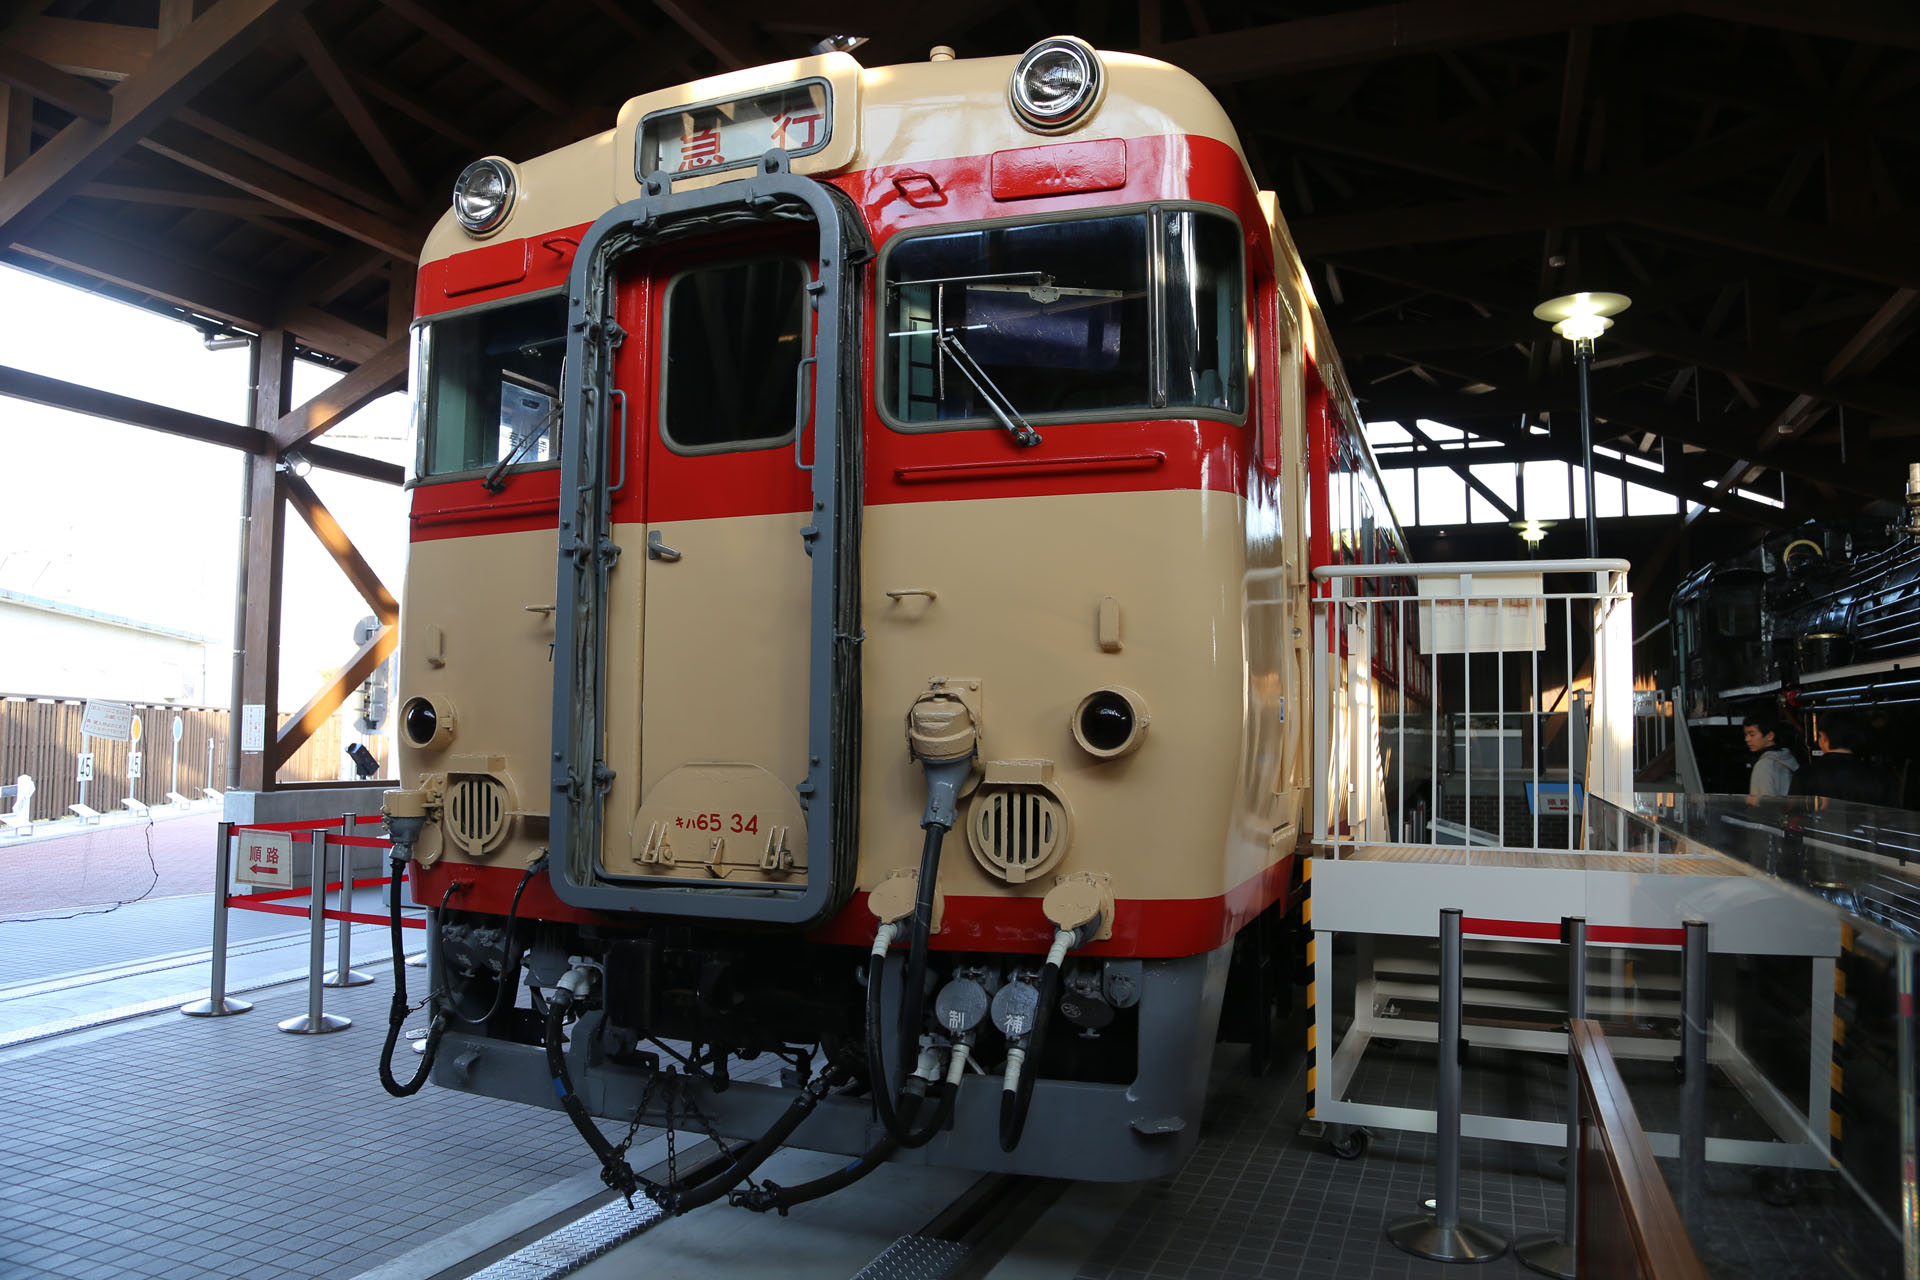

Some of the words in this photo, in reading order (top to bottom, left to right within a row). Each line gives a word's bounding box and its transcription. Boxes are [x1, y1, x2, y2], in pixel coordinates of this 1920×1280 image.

[678, 105, 825, 171] 急行
[80, 757, 91, 777] 45
[730, 813, 758, 835] 34
[249, 845, 279, 864] 順路
[949, 1010, 965, 1029] 制
[1004, 1014, 1024, 1033] 補
